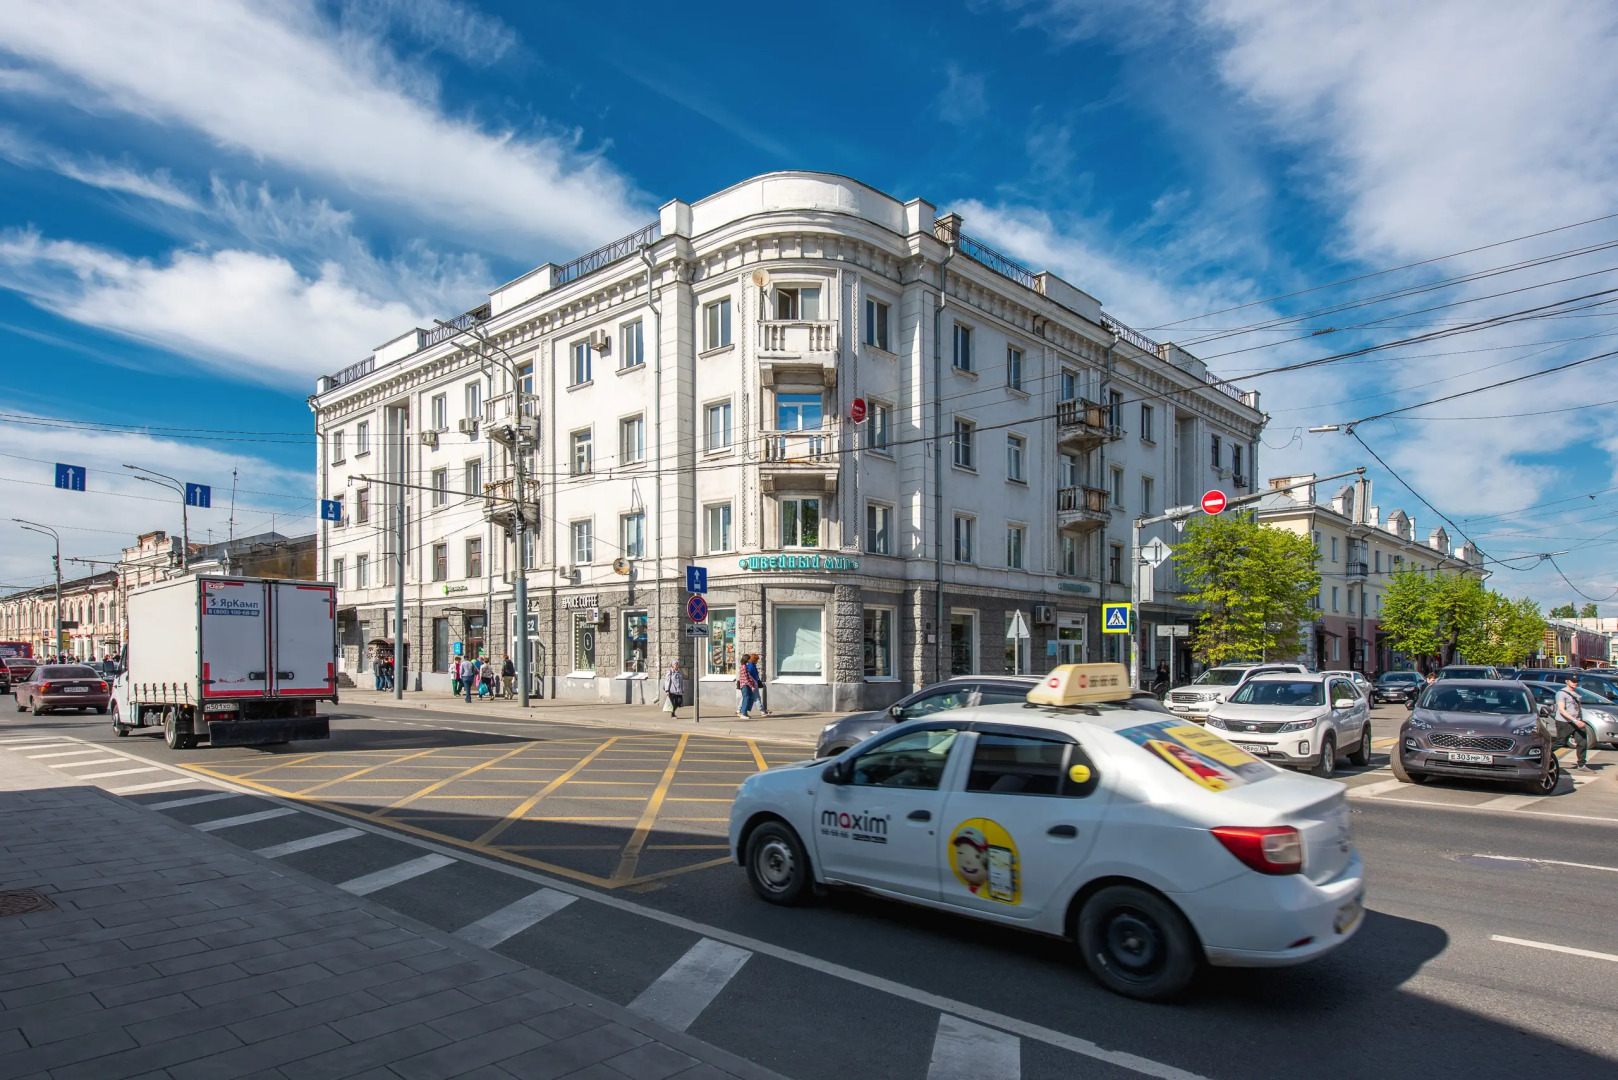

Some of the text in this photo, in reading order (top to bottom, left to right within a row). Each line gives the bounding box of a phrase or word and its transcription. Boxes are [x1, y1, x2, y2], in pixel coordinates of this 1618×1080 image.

[747, 553, 851, 571] ШВЕЙНЫЙ МИР
[220, 598, 259, 609] ЯрКамп
[565, 596, 579, 608] PRICE
[580, 594, 598, 608] COFFEE
[821, 810, 888, 835] maxim
